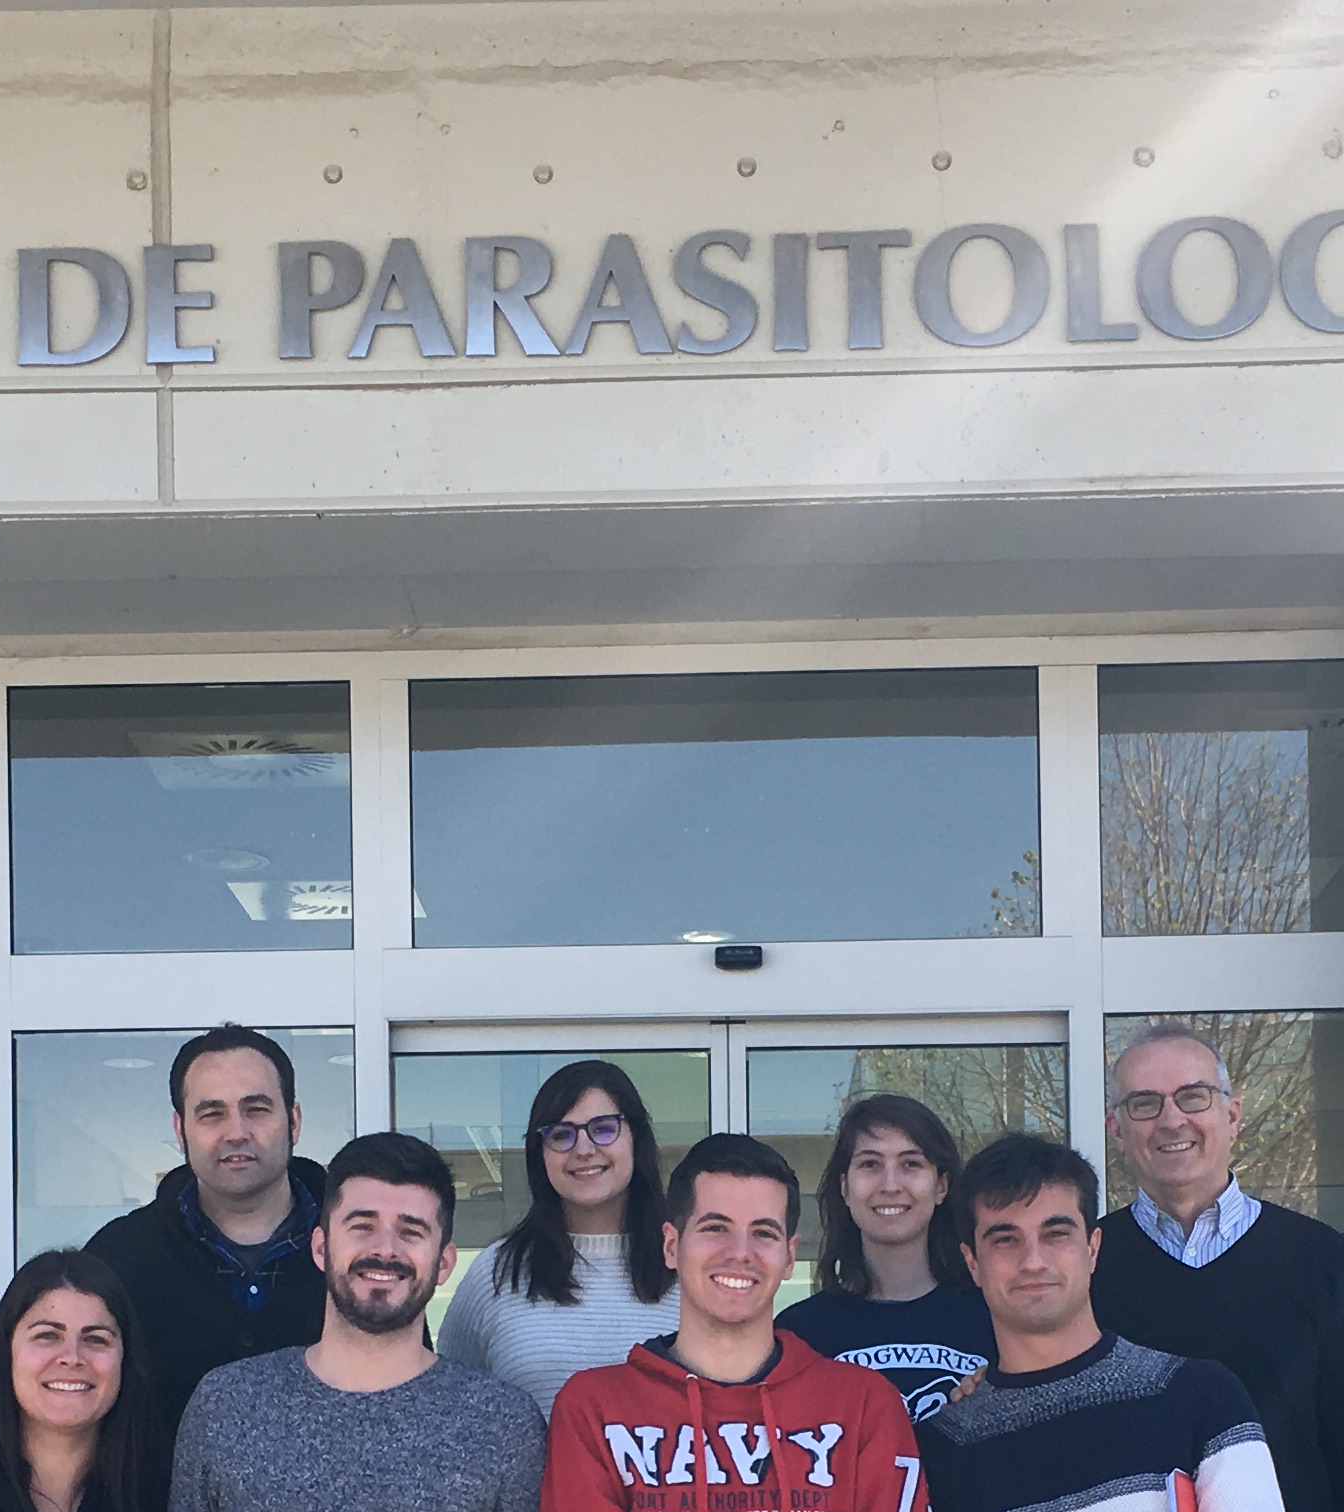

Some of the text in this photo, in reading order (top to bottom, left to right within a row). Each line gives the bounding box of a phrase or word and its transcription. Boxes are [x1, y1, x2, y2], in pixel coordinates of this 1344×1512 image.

[16, 243, 216, 367] DE
[604, 1422, 845, 1488] NAVY
[631, 1490, 667, 1510] ORT
[791, 1488, 830, 1509] DEPT
